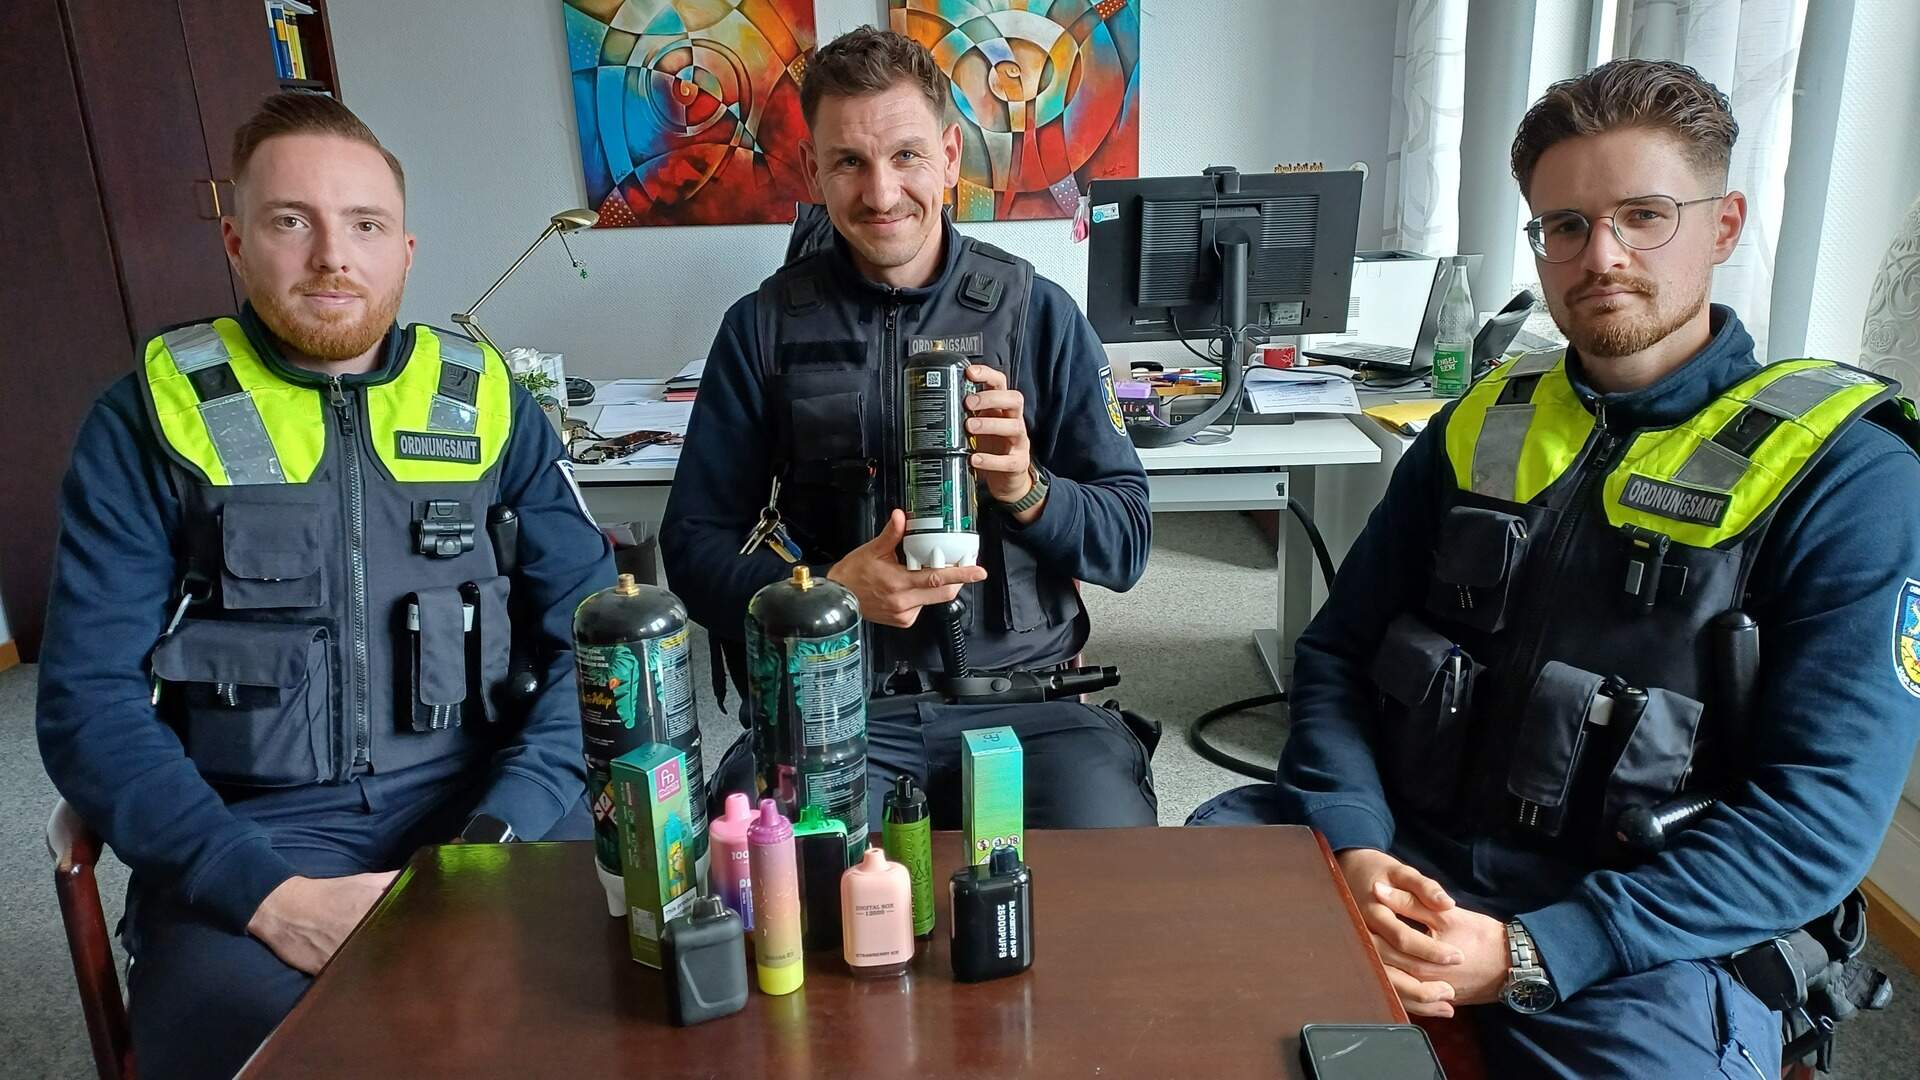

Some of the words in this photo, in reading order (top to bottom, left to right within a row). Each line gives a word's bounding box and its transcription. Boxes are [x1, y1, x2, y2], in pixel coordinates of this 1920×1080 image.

[912, 336, 979, 353] ORDNGSAMT
[400, 435, 477, 459] ORDNUNGSAMT
[1628, 480, 1724, 522] ORDNUNGSAMT
[997, 904, 1007, 959] 25000PUFFS
[1008, 900, 1017, 939] BLACKBERRY
